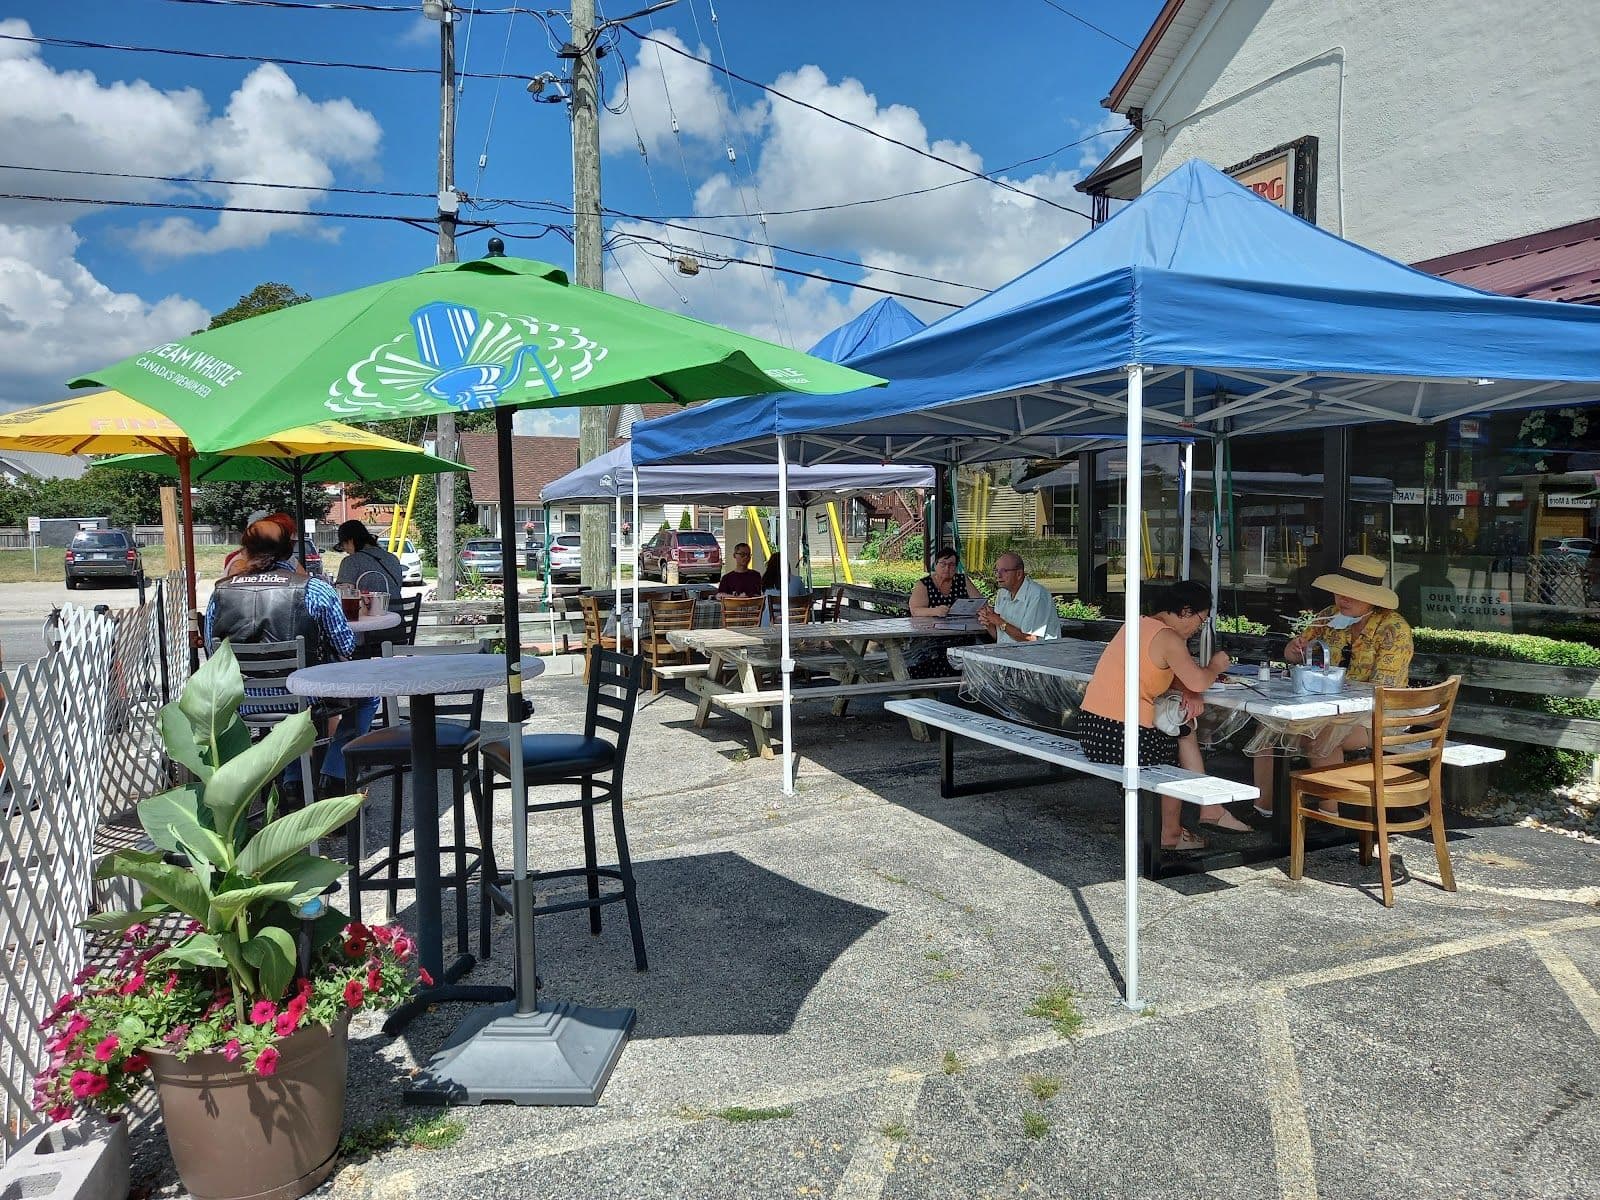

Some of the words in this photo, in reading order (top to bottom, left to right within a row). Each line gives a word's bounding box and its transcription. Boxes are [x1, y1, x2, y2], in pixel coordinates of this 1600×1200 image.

[1247, 177, 1284, 201] RG
[136, 357, 176, 381] CANADA'S
[147, 343, 197, 367] TEAM
[188, 352, 243, 388] WHISTLE
[230, 575, 257, 584] Lane
[258, 574, 288, 583] Rider
[1428, 593, 1452, 602] OUR
[1457, 594, 1501, 605] HEROES
[1426, 603, 1456, 613] WEAR
[1461, 605, 1506, 616] SCRUBS
